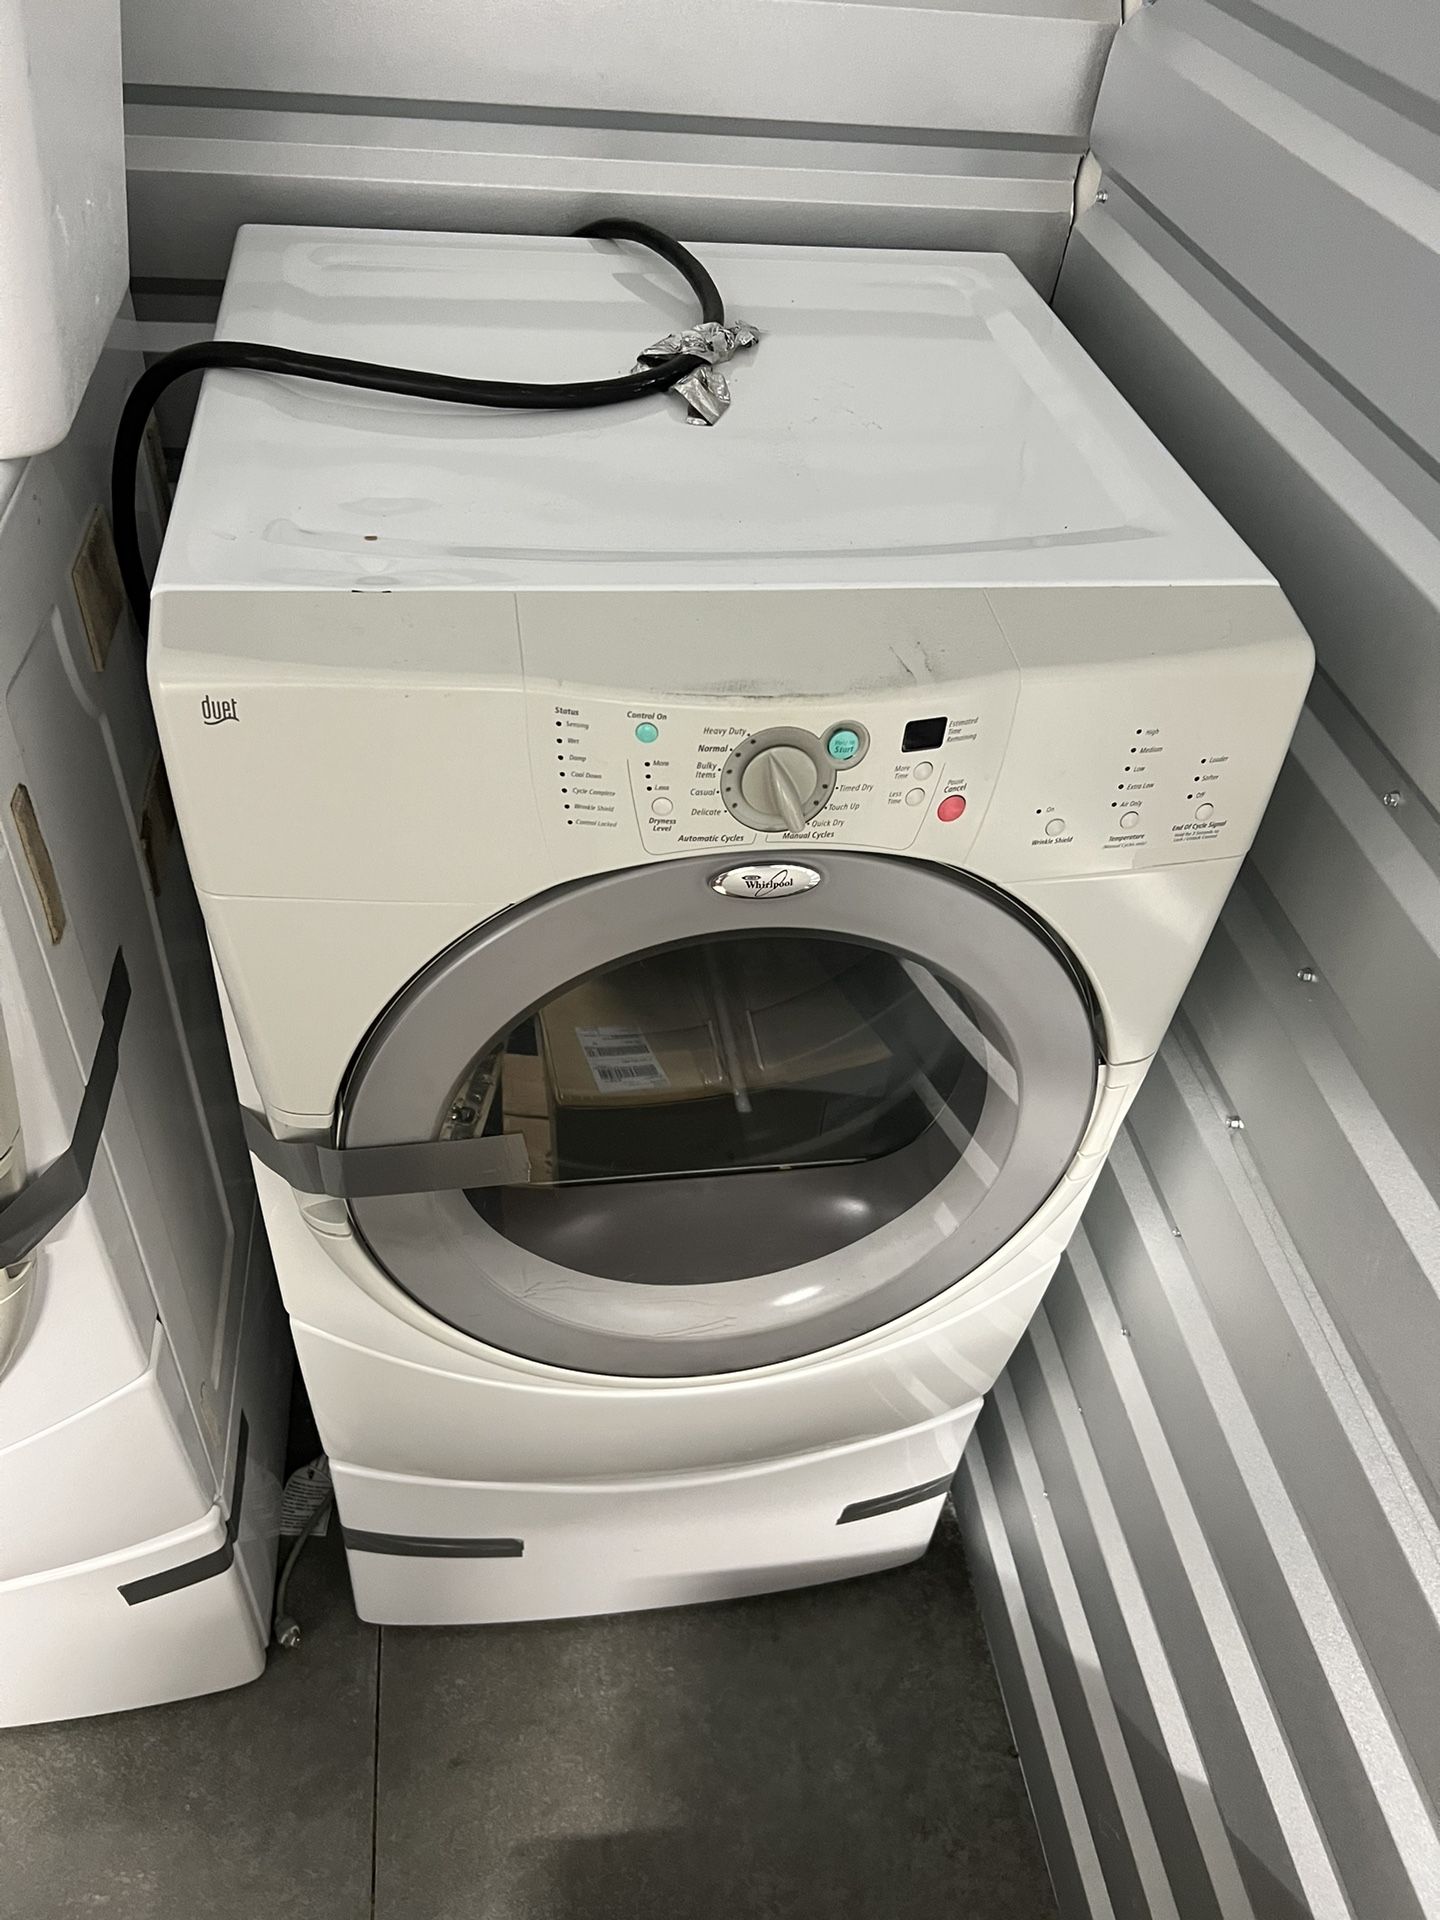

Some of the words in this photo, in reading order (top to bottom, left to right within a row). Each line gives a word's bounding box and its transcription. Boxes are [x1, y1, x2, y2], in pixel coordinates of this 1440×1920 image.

[201, 694, 240, 726] duet
[554, 706, 580, 717] Status
[626, 710, 656, 720] Control
[656, 713, 668, 721] On
[703, 726, 727, 737] Heavy
[728, 727, 747, 736] Duty
[697, 744, 729, 753] Normal
[696, 761, 718, 771] Bulky
[695, 771, 717, 779] Items
[690, 788, 716, 797] Casual
[839, 784, 862, 793] Timed
[861, 784, 874, 793] Dry
[943, 783, 968, 794] Cancel
[829, 804, 849, 812] Touch
[850, 803, 861, 811] Up
[690, 808, 722, 817] Delicate
[648, 817, 677, 826] Dryness
[811, 820, 831, 828] Quick
[832, 819, 845, 828] Dry
[677, 834, 719, 843] Automatic
[720, 834, 745, 844] Cycles
[782, 831, 811, 840] Manual
[811, 831, 835, 840] Cycles
[745, 878, 794, 890] Whirlpool
